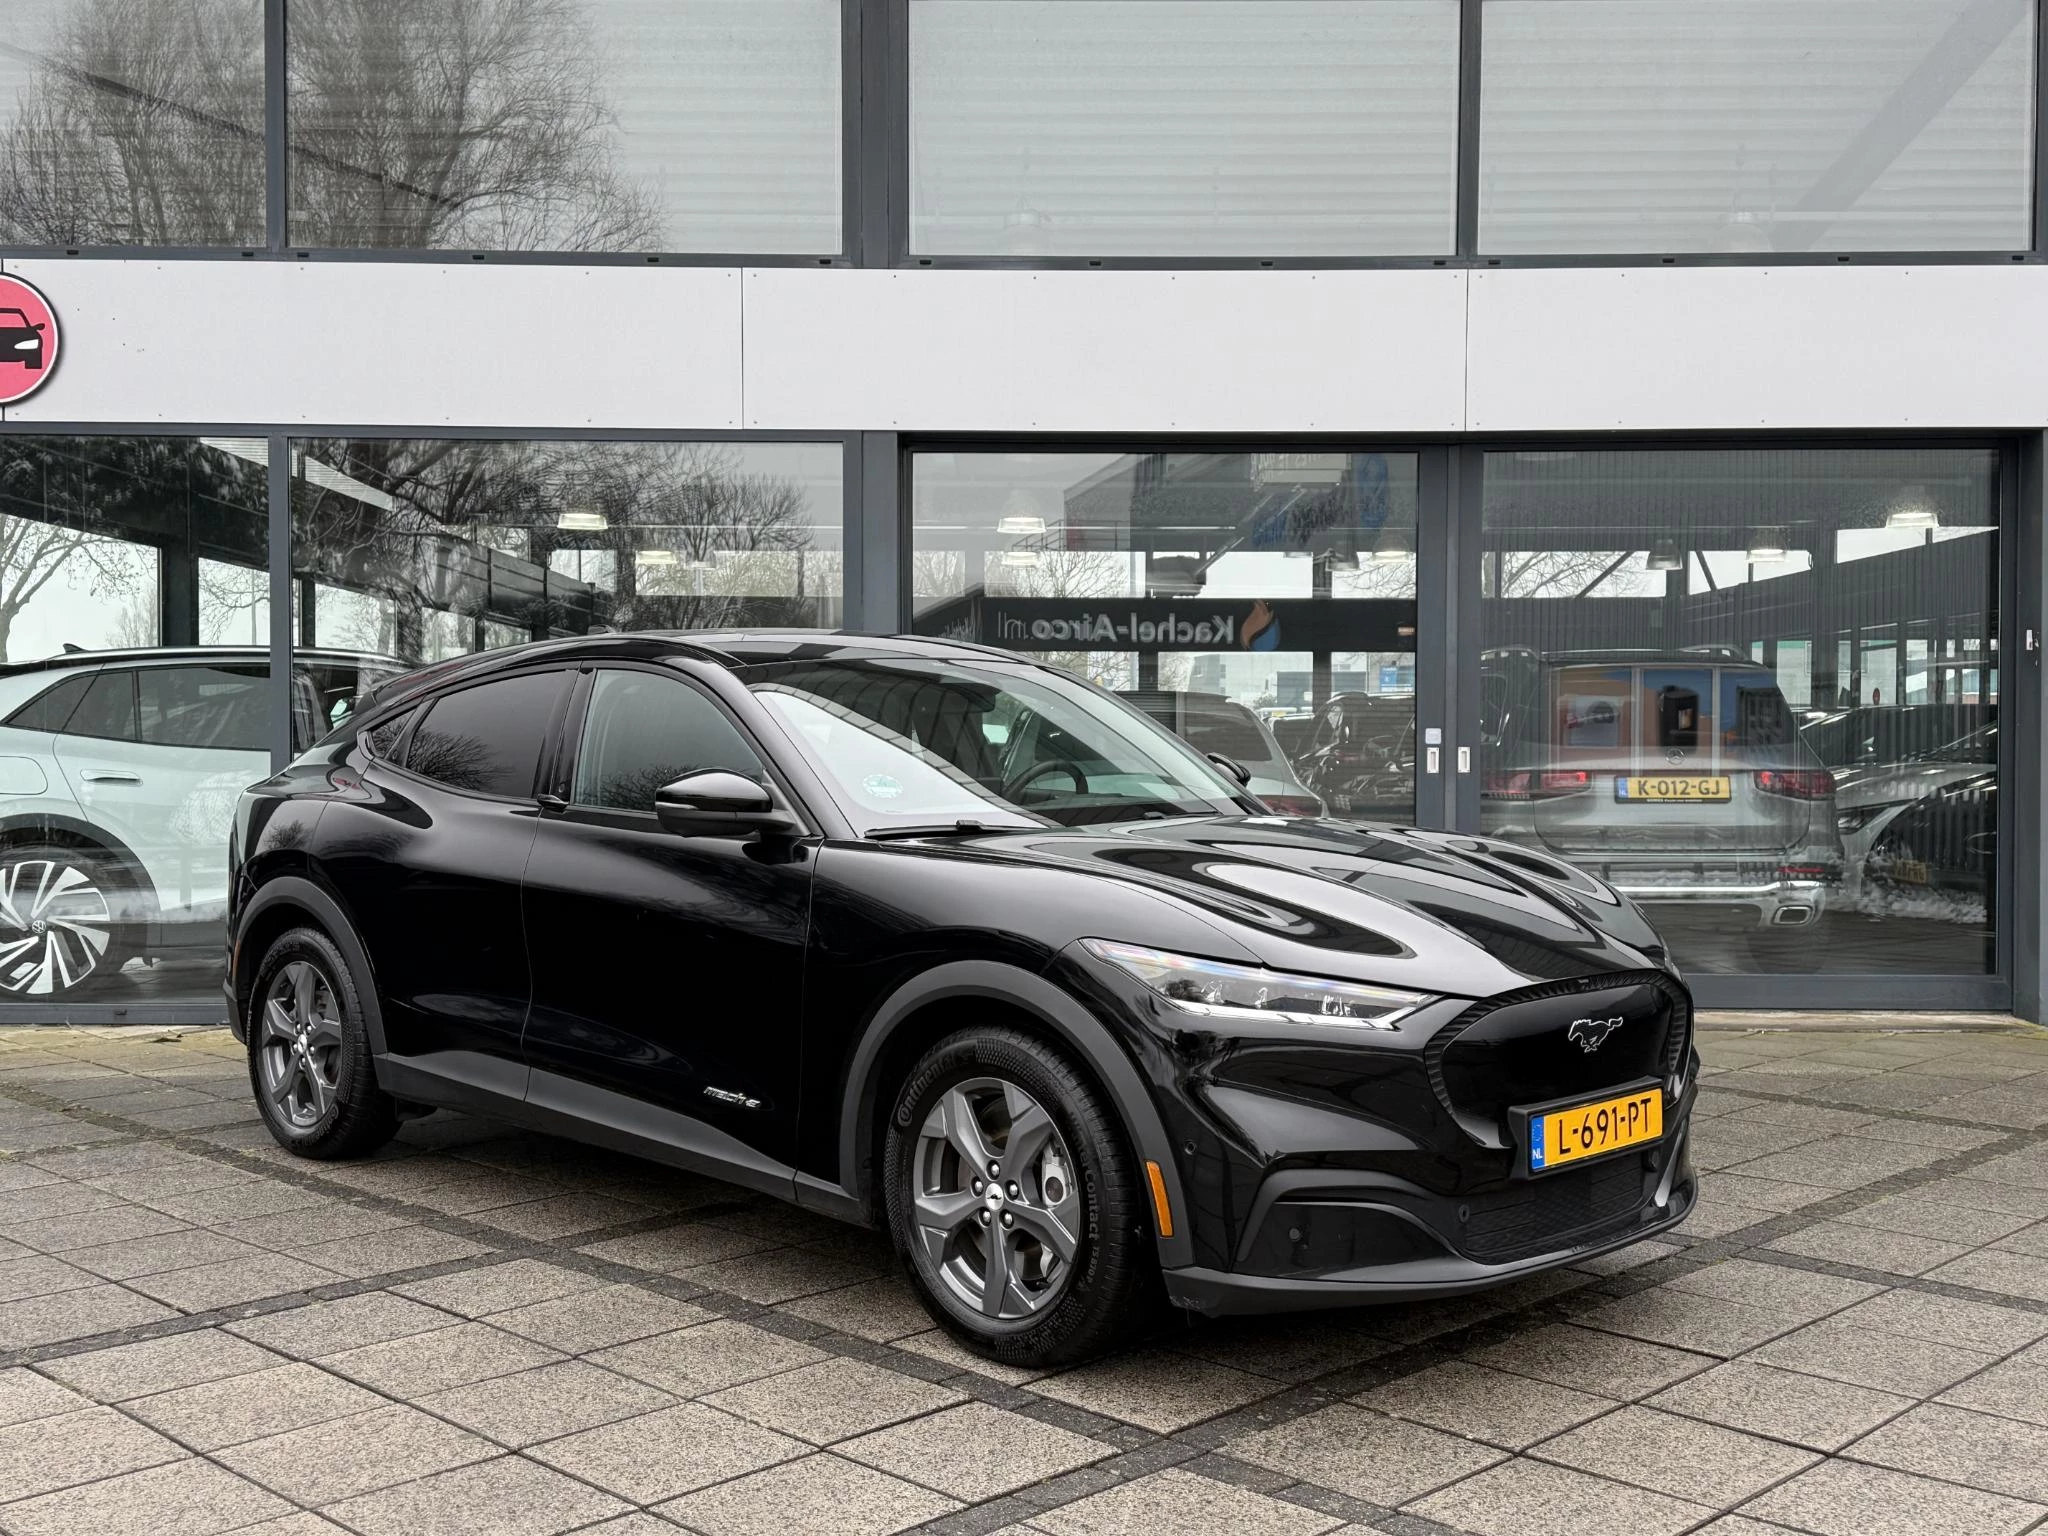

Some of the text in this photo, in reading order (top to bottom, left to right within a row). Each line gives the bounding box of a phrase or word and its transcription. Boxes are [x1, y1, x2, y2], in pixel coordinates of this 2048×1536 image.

[1637, 779, 1721, 796] K-012-GJ
[1558, 1097, 1653, 1155] L-691-PT
[1532, 1148, 1543, 1160] NL
